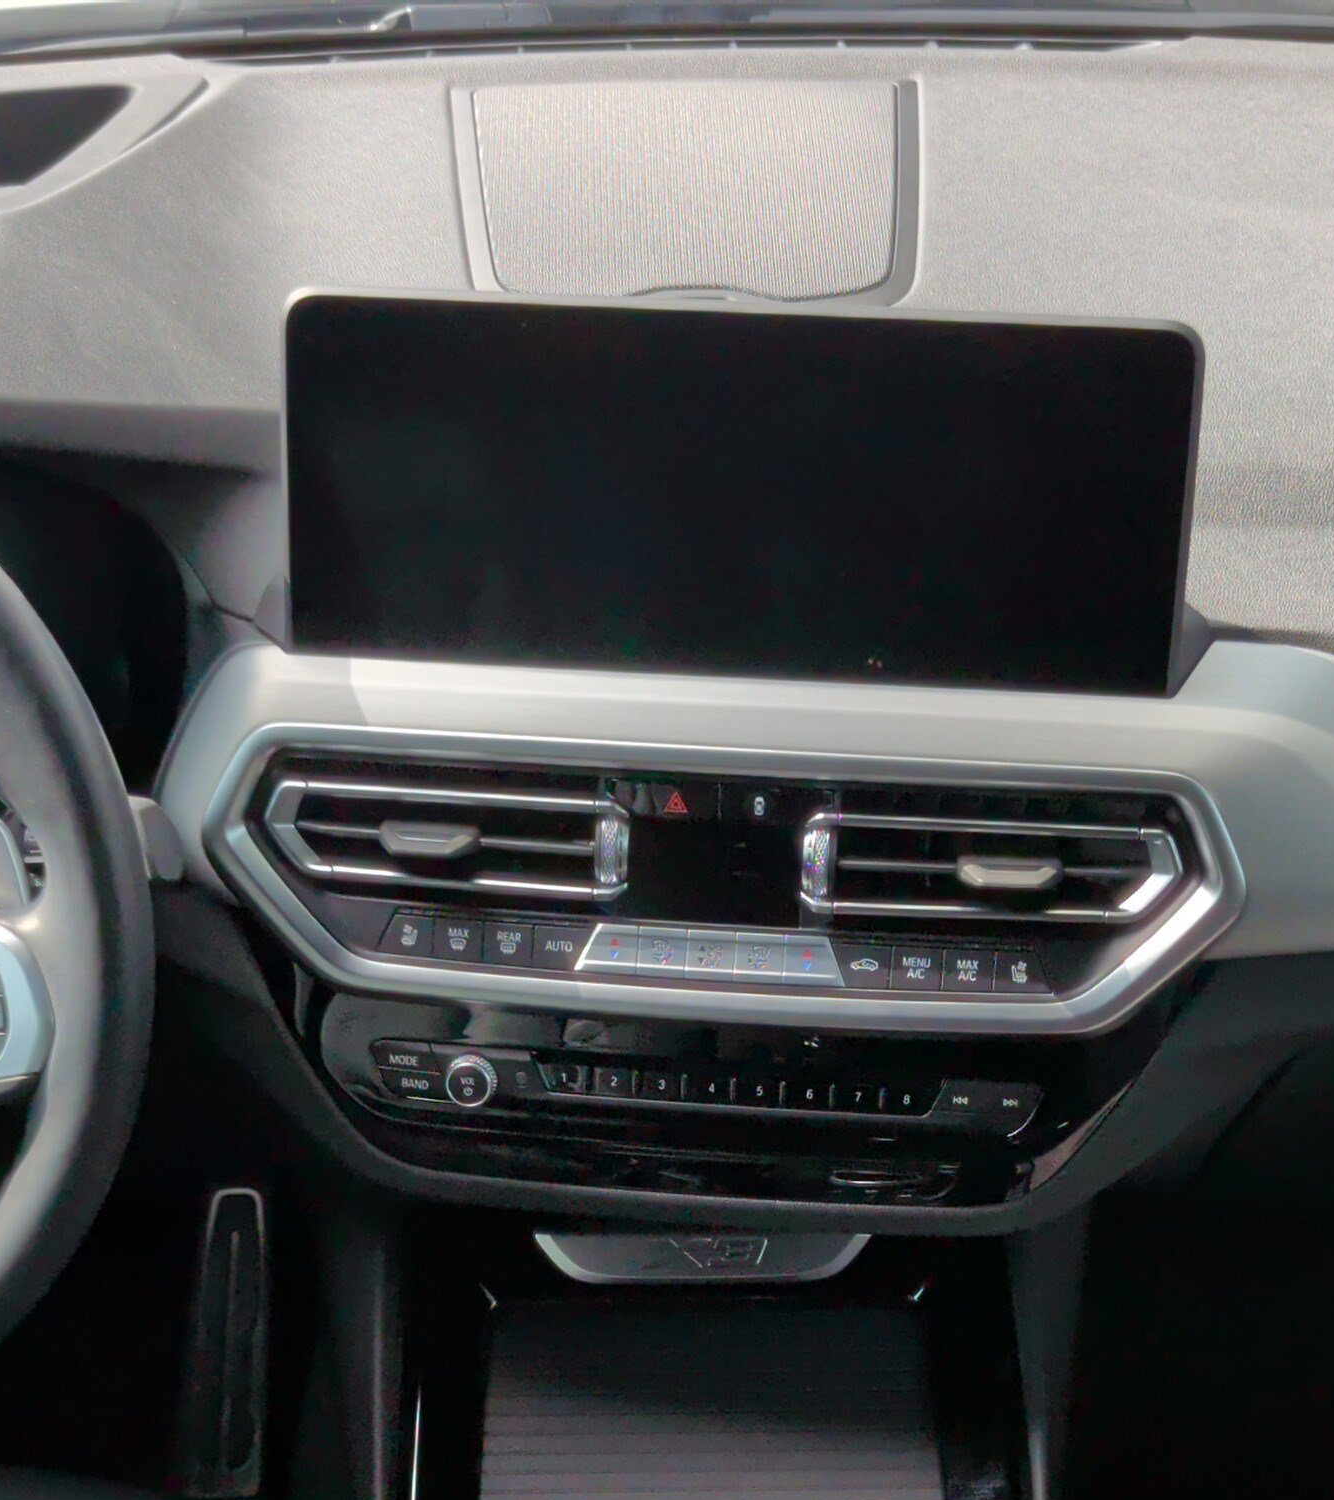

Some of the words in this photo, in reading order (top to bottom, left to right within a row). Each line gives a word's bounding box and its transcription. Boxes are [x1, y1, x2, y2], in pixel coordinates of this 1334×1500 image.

[448, 927, 470, 939] MAX
[496, 931, 522, 943] REAR
[545, 940, 573, 953] AUTO
[902, 956, 931, 969] MENU
[956, 959, 979, 971] MAX
[906, 968, 926, 980] A/C
[958, 970, 977, 982] A/C
[388, 1053, 418, 1067] MODE
[401, 1077, 429, 1090] BAND
[460, 1076, 475, 1087] VOL
